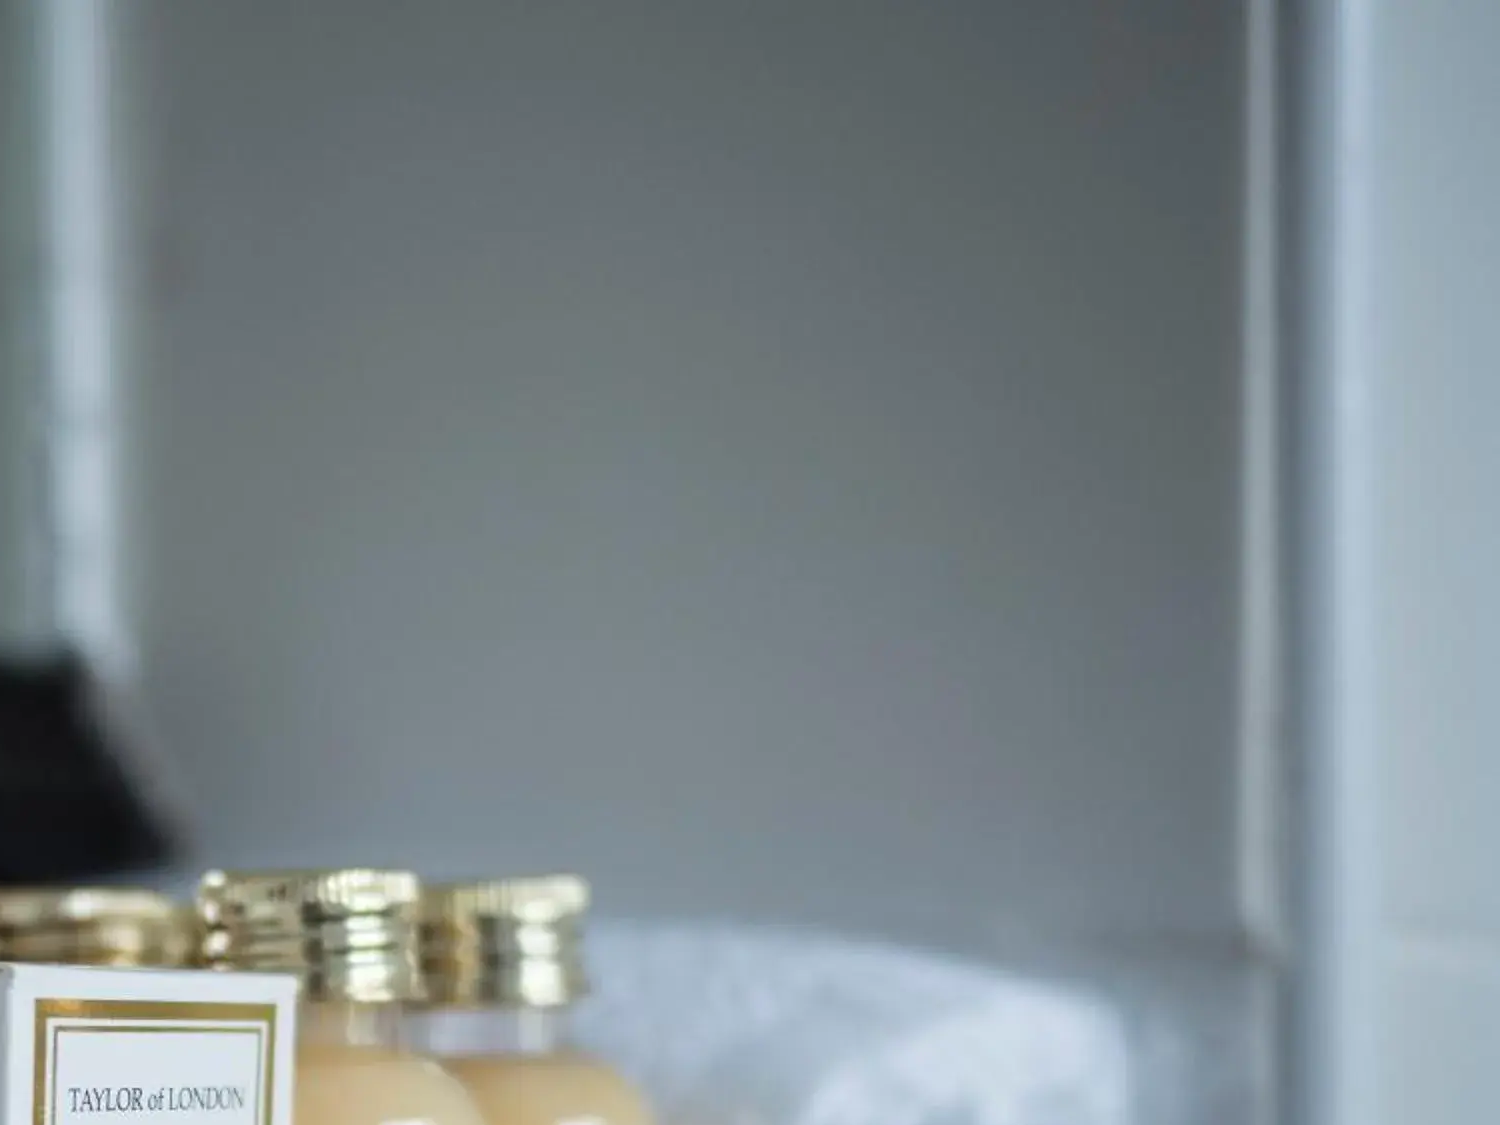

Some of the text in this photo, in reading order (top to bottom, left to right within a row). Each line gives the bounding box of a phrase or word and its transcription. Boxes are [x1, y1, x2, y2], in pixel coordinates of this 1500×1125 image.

[68, 1084, 245, 1114] TAYLOR of LONDON
